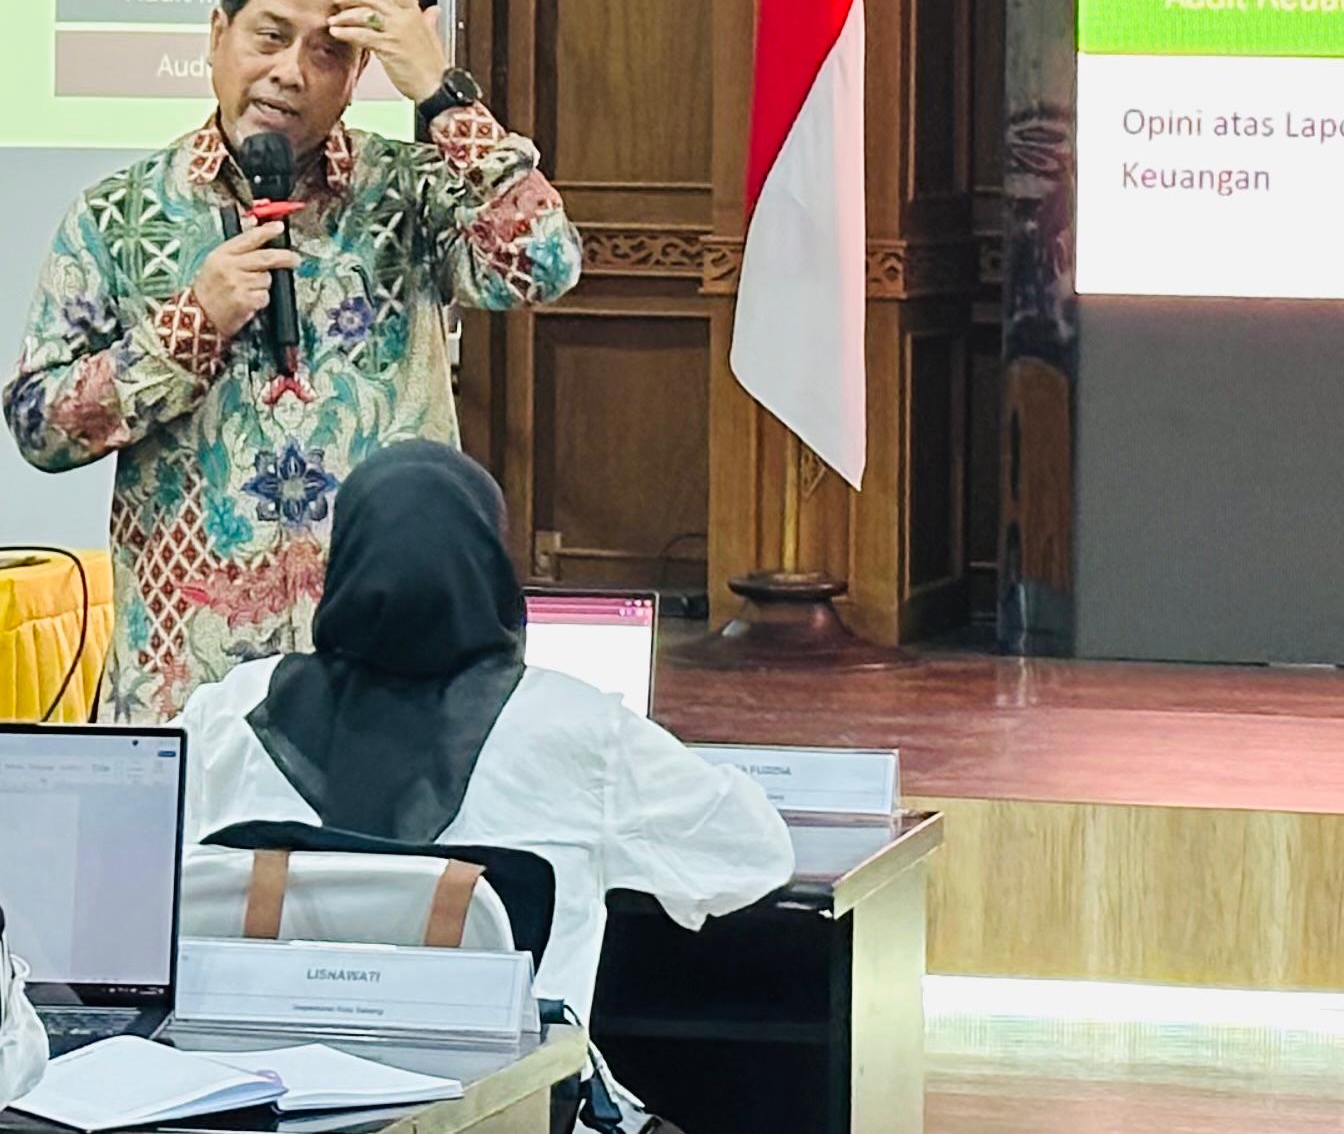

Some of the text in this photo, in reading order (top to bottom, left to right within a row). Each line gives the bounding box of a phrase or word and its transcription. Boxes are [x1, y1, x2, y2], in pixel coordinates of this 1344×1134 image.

[1123, 109, 1202, 140] Opini
[1214, 112, 1274, 137] atas
[1123, 162, 1270, 196] Keuangan
